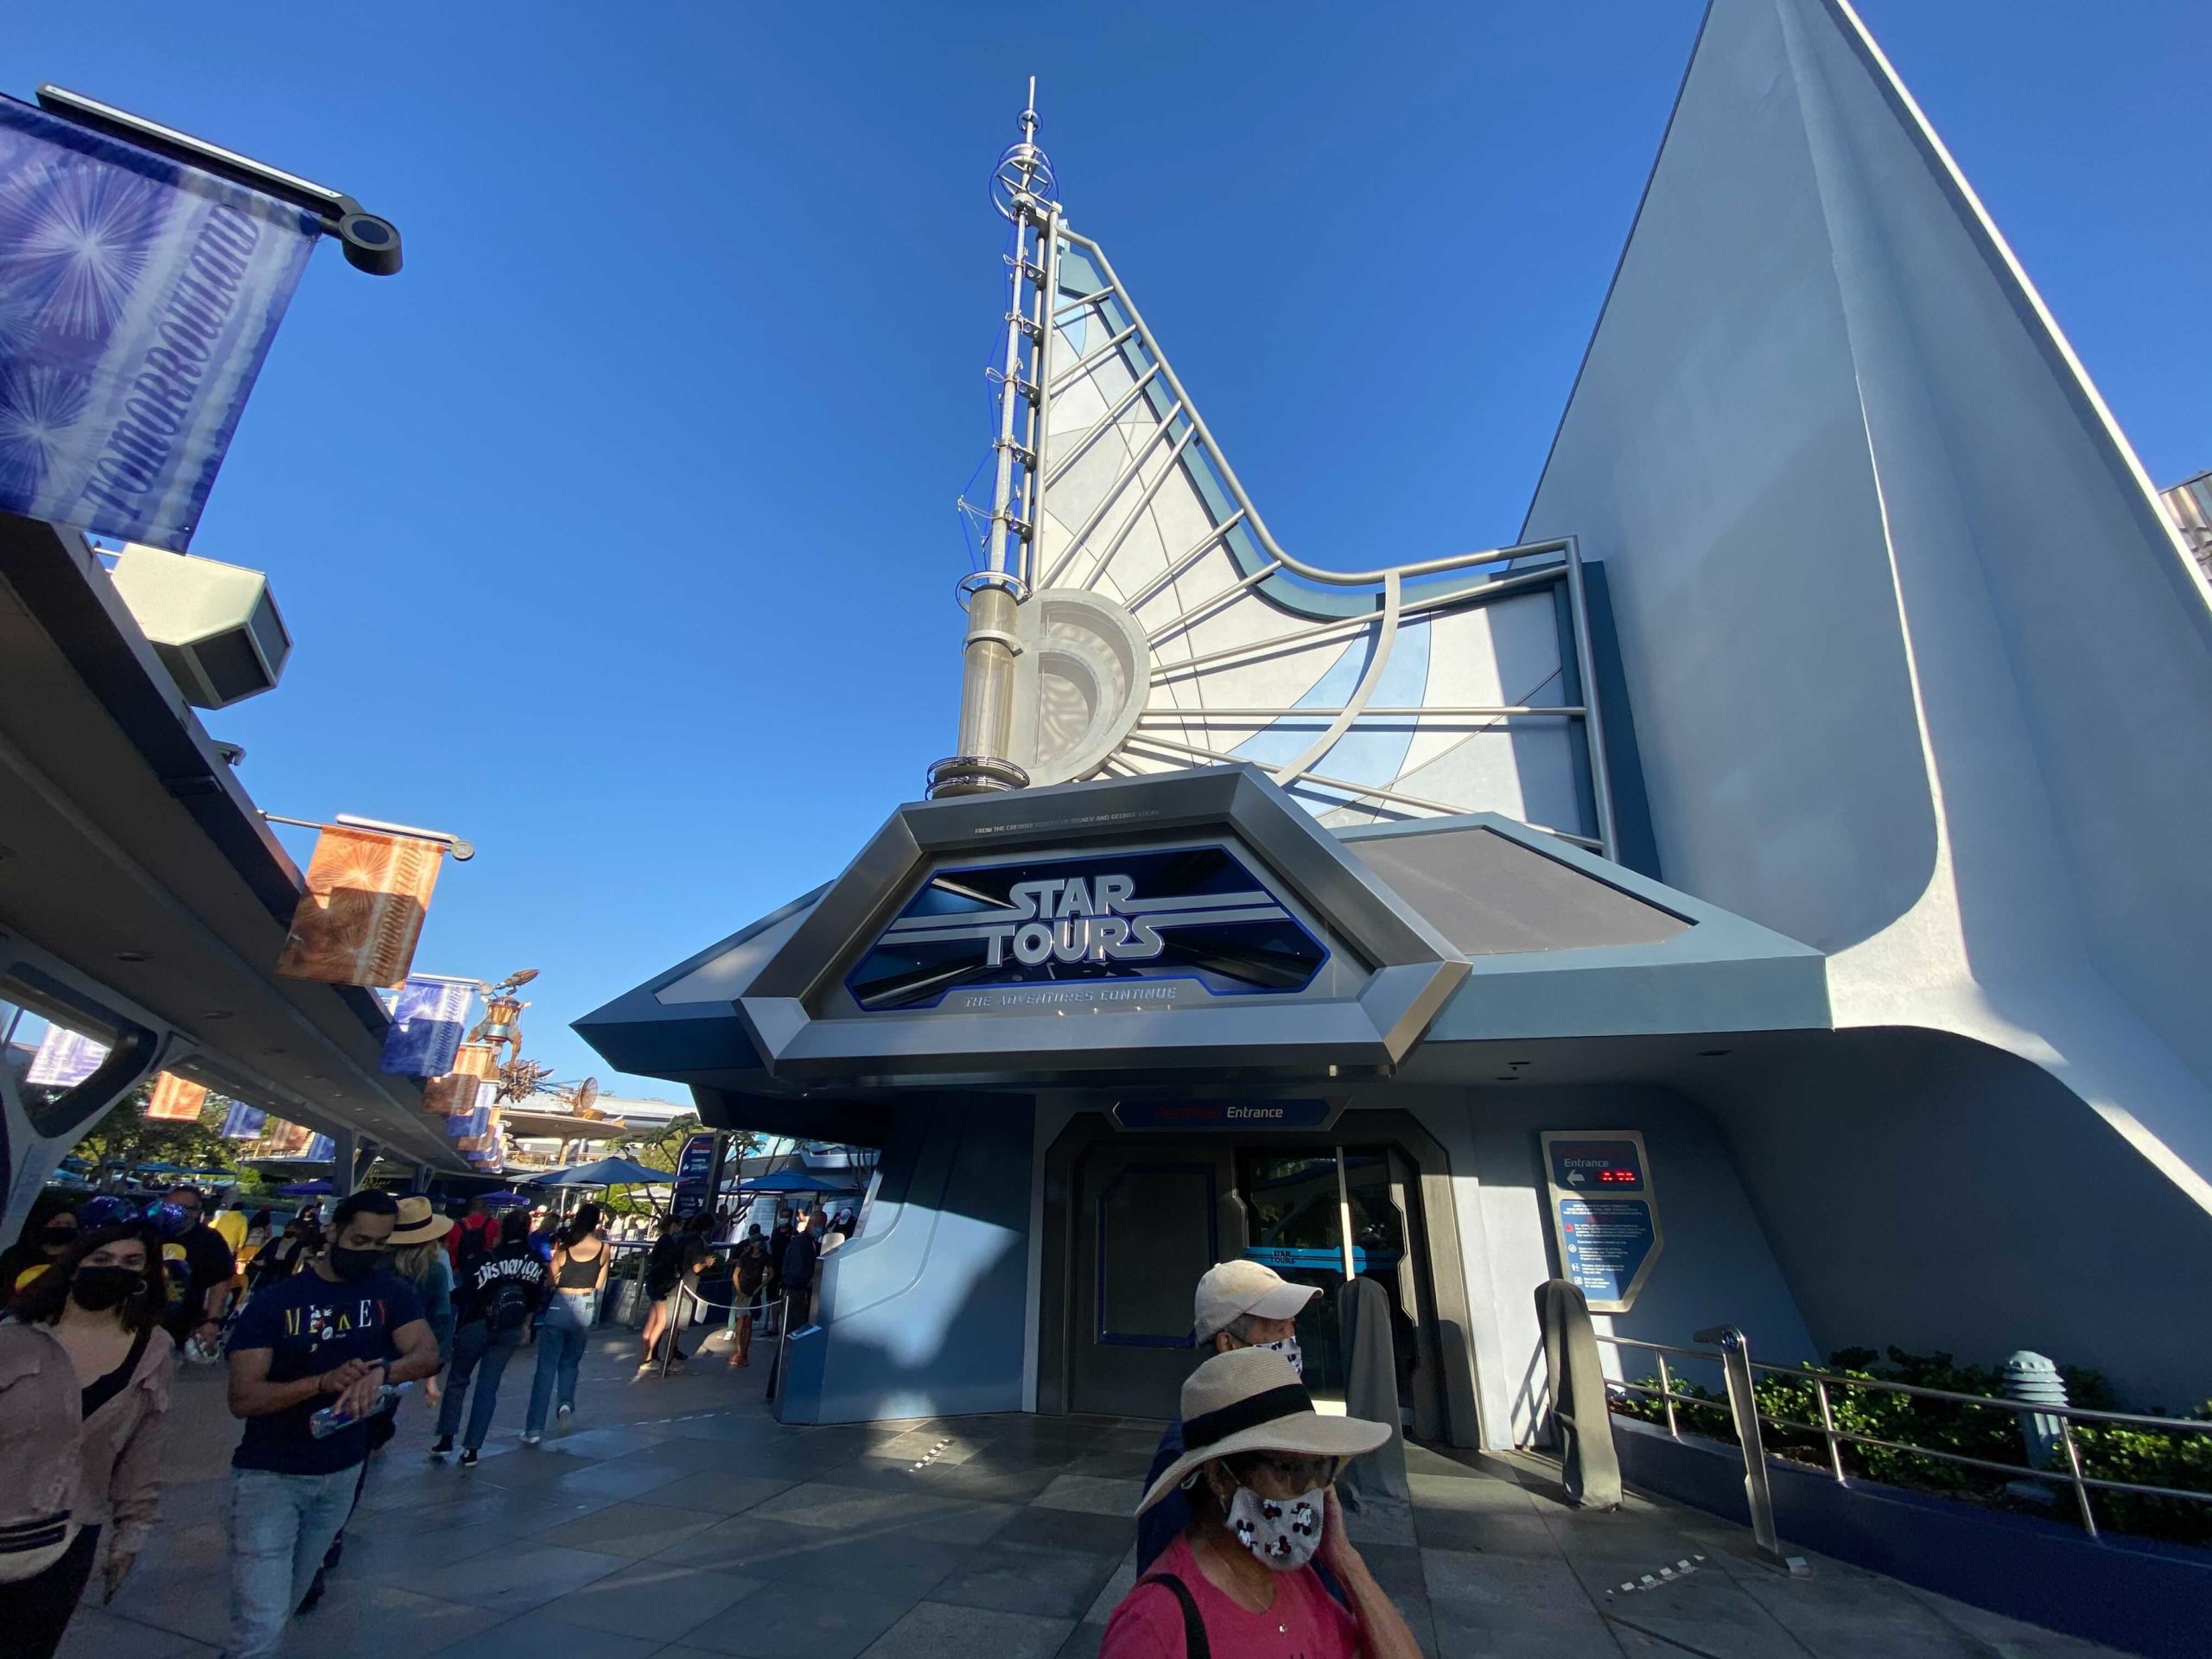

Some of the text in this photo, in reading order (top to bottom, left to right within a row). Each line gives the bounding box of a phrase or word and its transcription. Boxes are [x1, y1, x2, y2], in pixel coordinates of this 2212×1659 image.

[81, 203, 259, 521] TOMORROWLAND
[975, 826, 993, 835] FROM
[1006, 823, 1034, 831] CREATIVE
[1110, 811, 1136, 820] GEORGE
[1008, 874, 1135, 919] STAR
[985, 916, 1166, 968] TOURS
[965, 987, 1177, 1008] THE ADVENTURES CONTINUE
[1226, 1106, 1284, 1119] Entrance
[1564, 1158, 1610, 1168] Entrance
